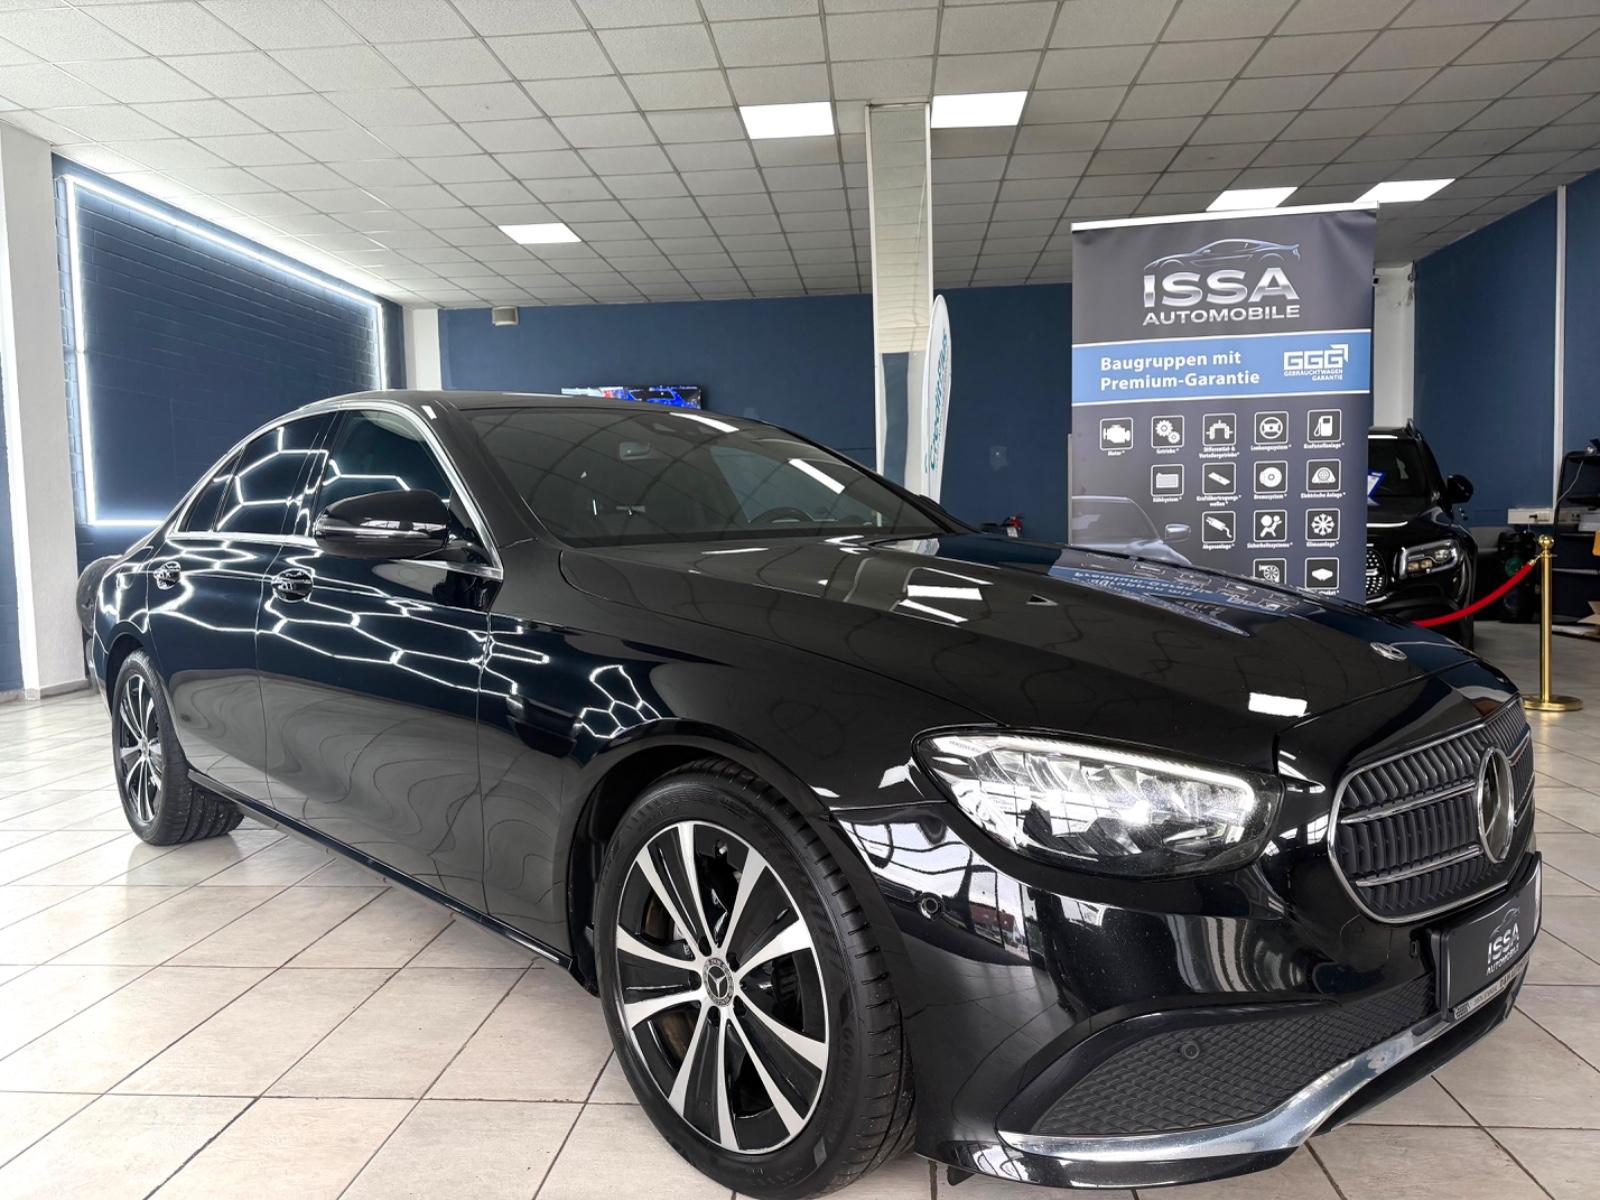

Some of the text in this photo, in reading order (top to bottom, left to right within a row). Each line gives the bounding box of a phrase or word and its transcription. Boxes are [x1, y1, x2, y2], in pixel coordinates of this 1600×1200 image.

[1143, 267, 1300, 308] ISSA
[1143, 305, 1300, 326] AUTOMOBILE
[1101, 351, 1241, 373] Baugruppen mit
[1284, 349, 1343, 370] GGG
[1101, 370, 1260, 391] Premium-Garantie
[1284, 369, 1343, 377] GEBRAUCHTWAGEN
[1487, 922, 1520, 965] ISSA
